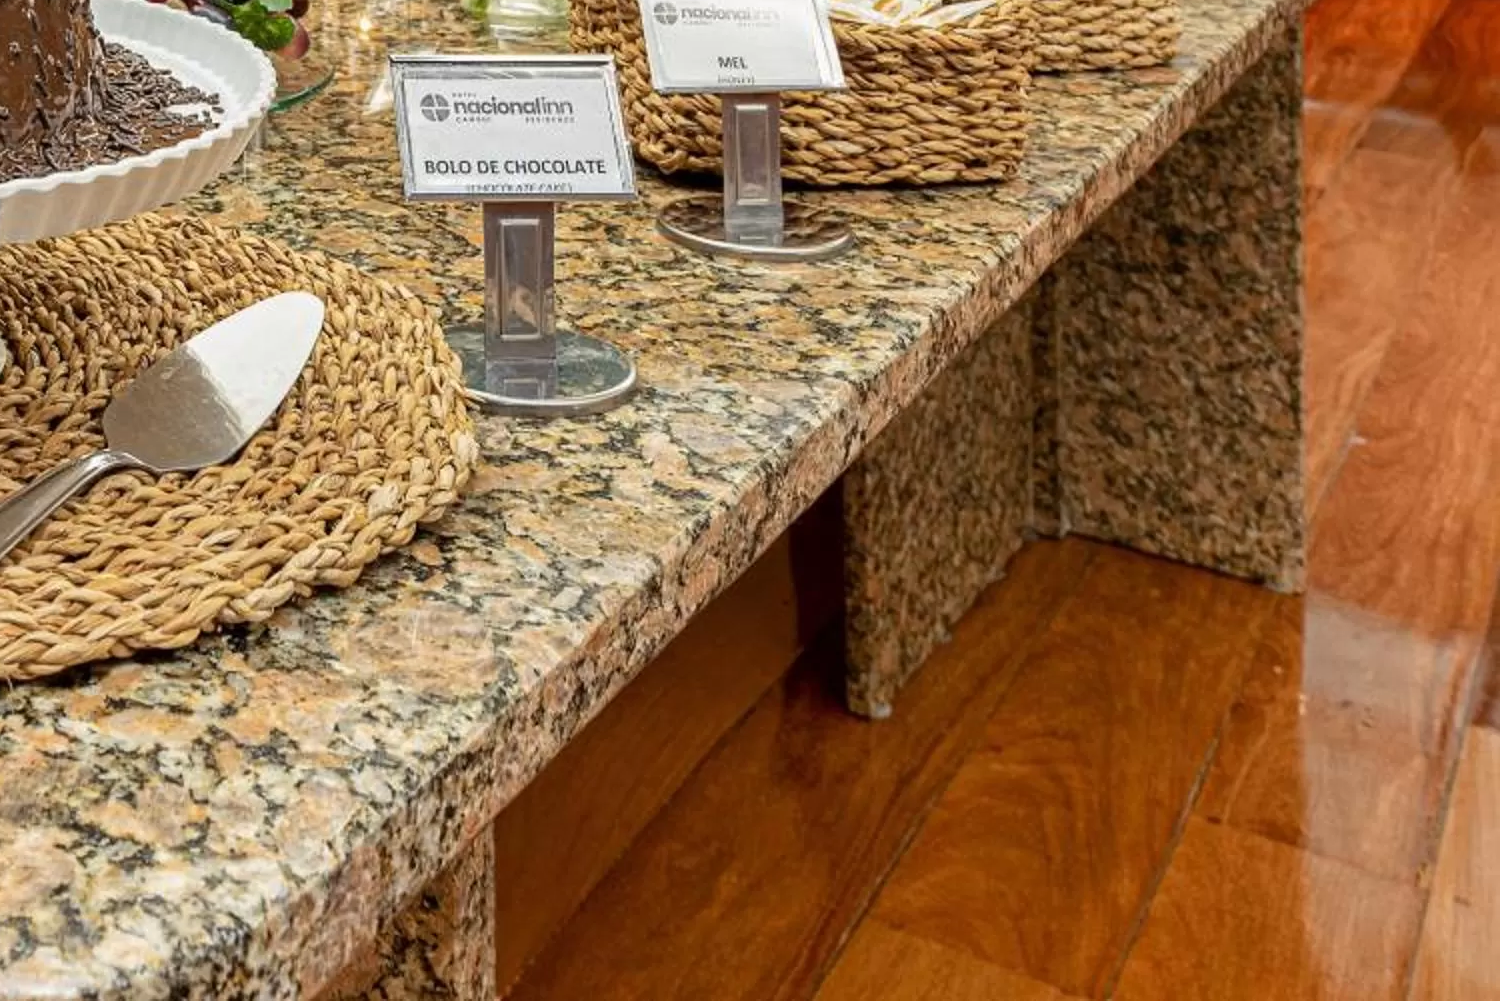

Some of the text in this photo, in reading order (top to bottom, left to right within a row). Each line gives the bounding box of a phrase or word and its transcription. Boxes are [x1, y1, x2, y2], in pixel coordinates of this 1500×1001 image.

[717, 56, 748, 70] MEL
[424, 160, 607, 174] BOLO DE CHOCOLATE
